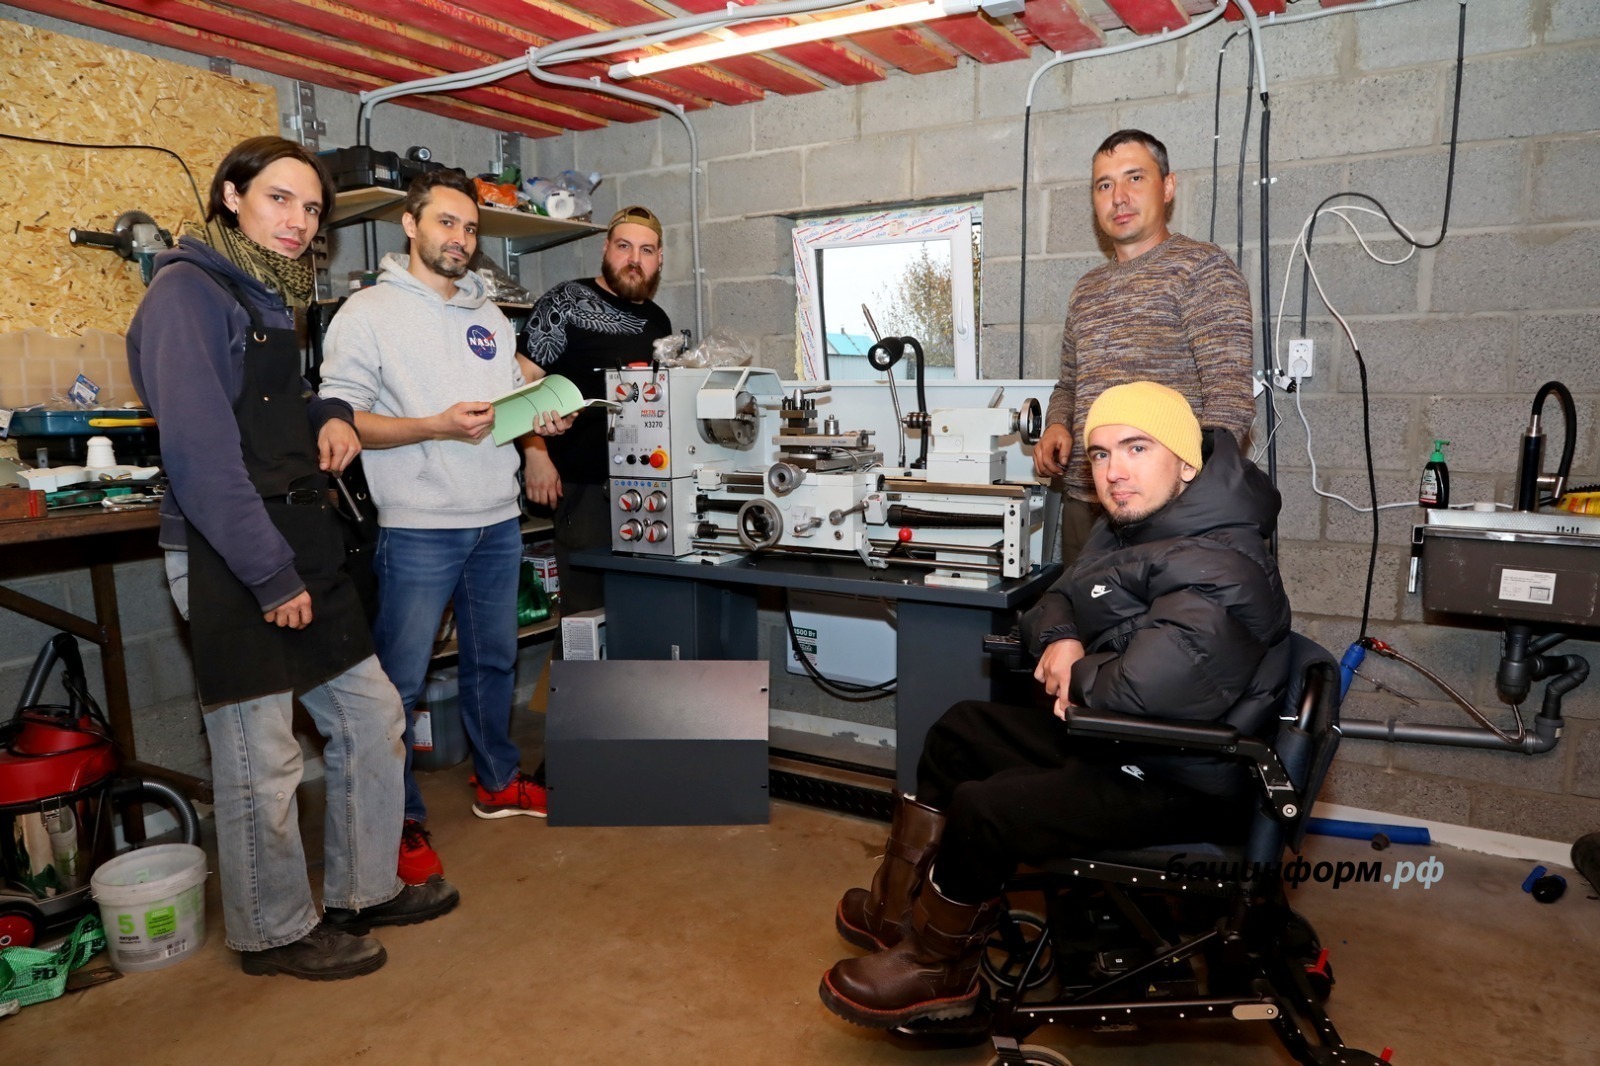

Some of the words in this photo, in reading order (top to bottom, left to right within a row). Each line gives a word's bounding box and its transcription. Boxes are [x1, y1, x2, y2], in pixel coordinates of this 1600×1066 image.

[469, 337, 495, 348] NASA
[644, 421, 663, 429] X3270
[118, 915, 135, 934] 5
